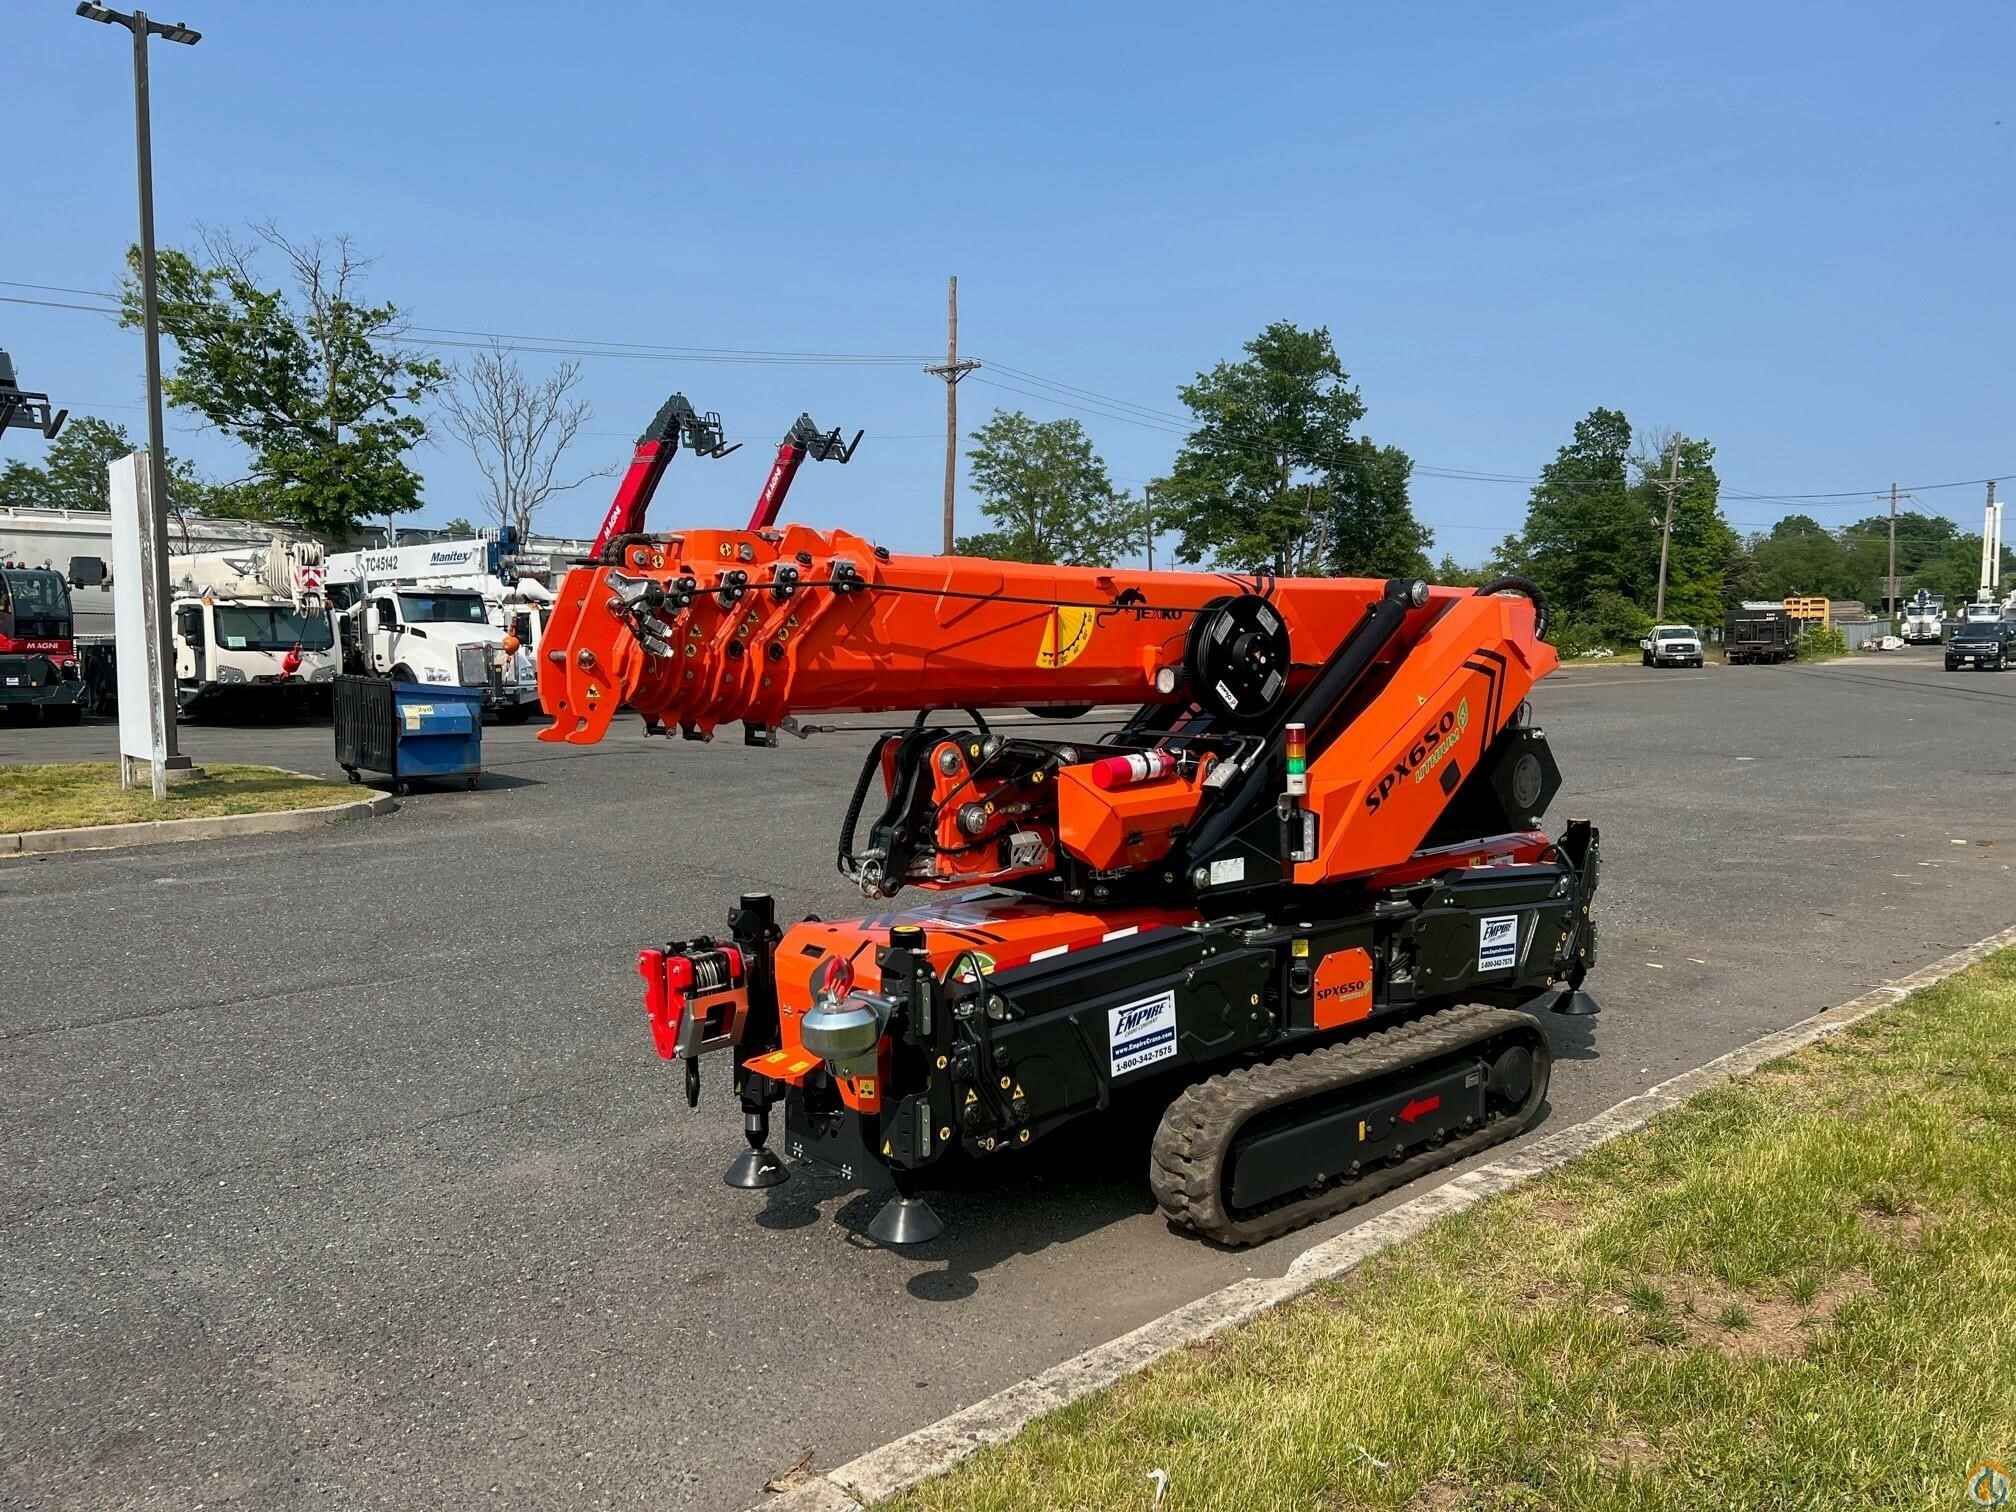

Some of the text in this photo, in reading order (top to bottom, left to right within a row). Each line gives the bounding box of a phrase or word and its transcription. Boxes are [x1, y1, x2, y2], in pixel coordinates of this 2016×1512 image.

[365, 555, 399, 572] TC45142
[431, 551, 472, 563] Manitex
[26, 642, 59, 650] MAGNI
[1365, 711, 1455, 816] SPX650
[1317, 980, 1365, 1001] SPX650
[1114, 1001, 1168, 1037] EMPIRE
[1115, 1045, 1174, 1073] 1-800-342-7575
